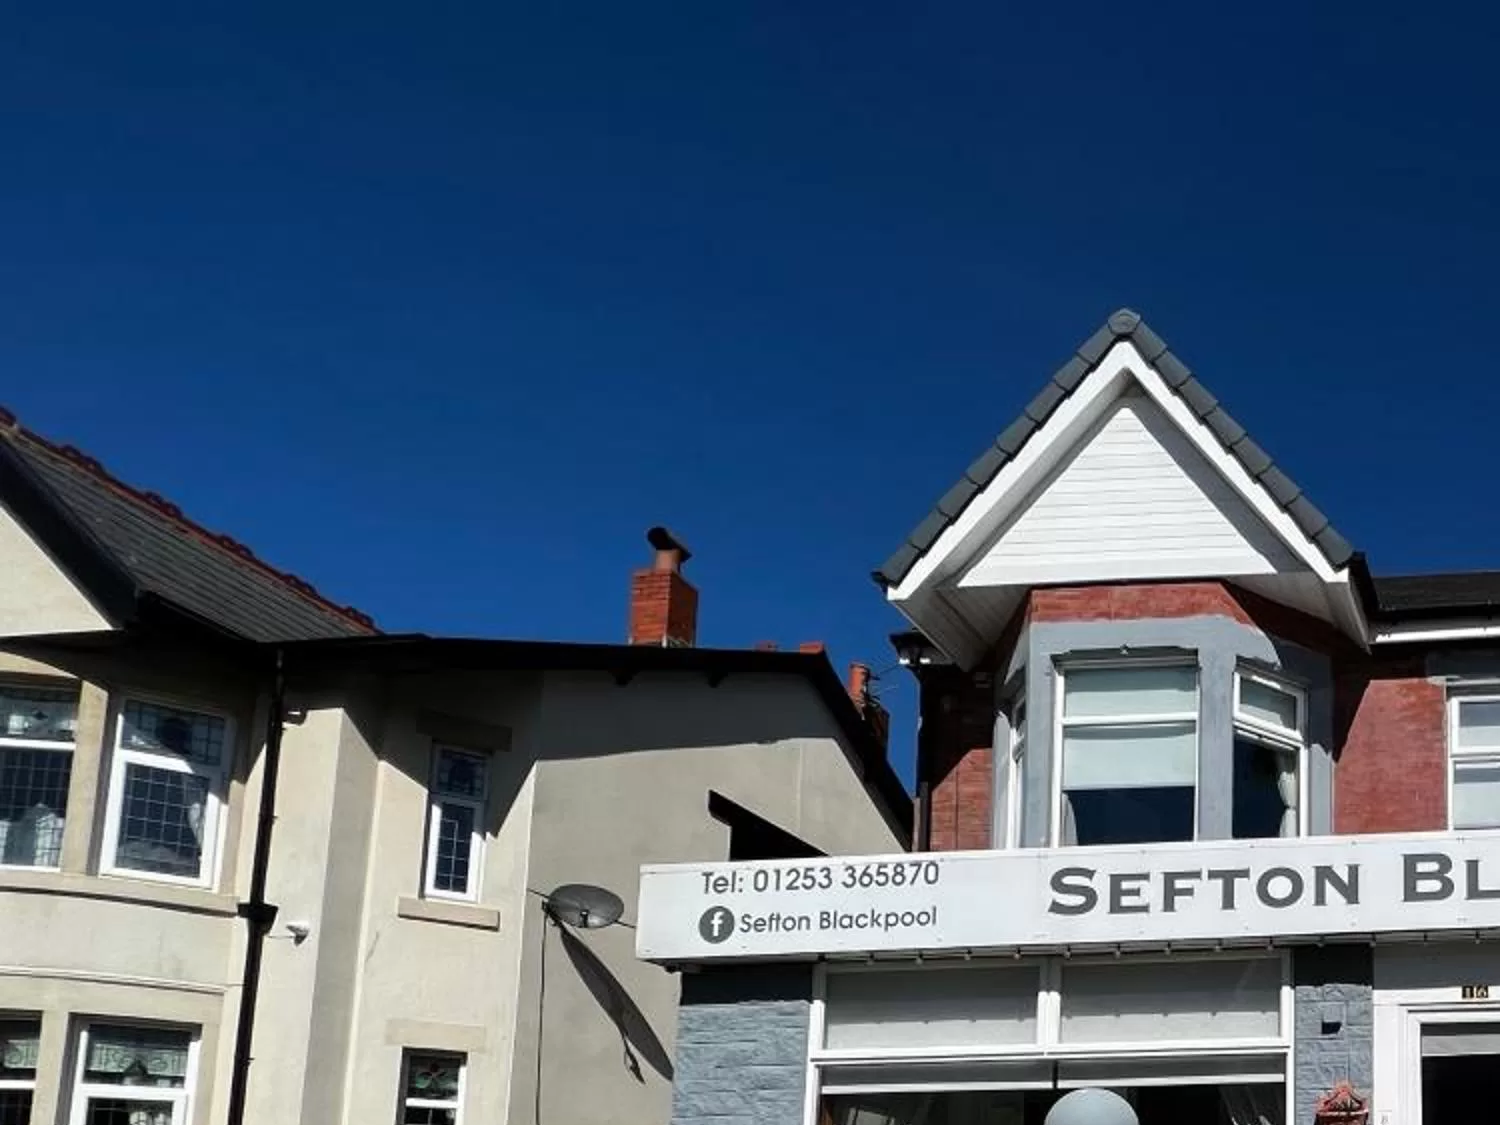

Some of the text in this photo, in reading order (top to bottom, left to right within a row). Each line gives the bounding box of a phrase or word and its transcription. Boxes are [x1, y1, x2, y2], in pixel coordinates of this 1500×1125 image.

[702, 861, 940, 895] Tel: 01253 365870
[1048, 863, 1361, 916] SEFTON
[739, 912, 811, 934] Sefton
[819, 906, 937, 932] Blackpool
